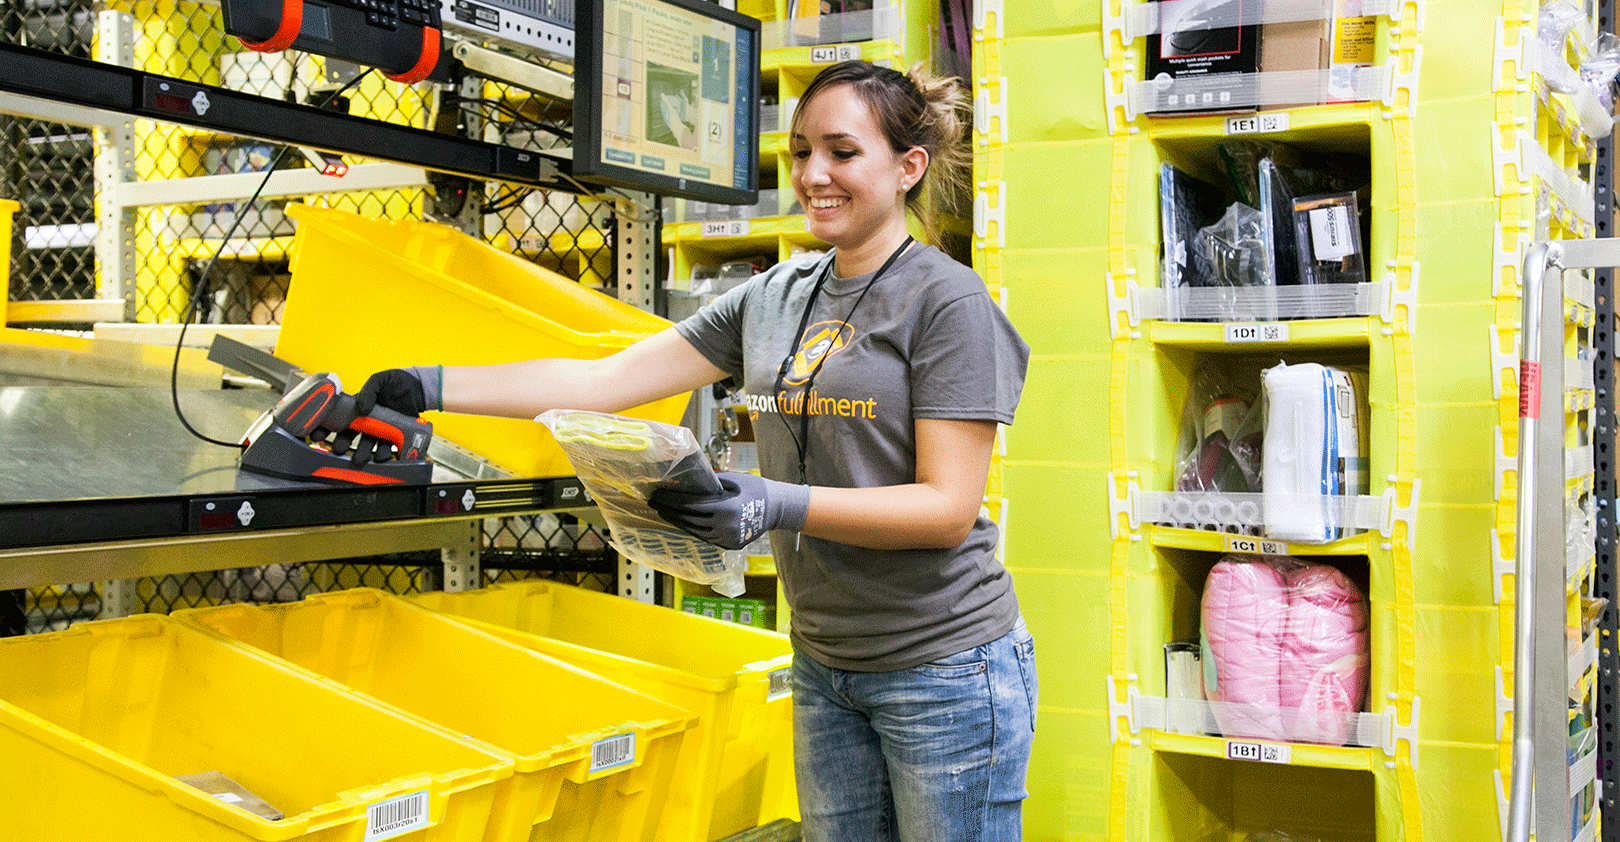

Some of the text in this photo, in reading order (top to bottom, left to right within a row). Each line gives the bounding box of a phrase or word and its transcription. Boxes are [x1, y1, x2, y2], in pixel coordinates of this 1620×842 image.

[713, 57, 719, 72] 1
[708, 120, 721, 139] (2)
[1232, 120, 1247, 131] 1E
[707, 224, 720, 234] 3H
[1328, 222, 1337, 247] SIRIUS
[1233, 328, 1250, 338] 1D
[1232, 540, 1249, 551] 1C
[1233, 745, 1250, 756] 1B
